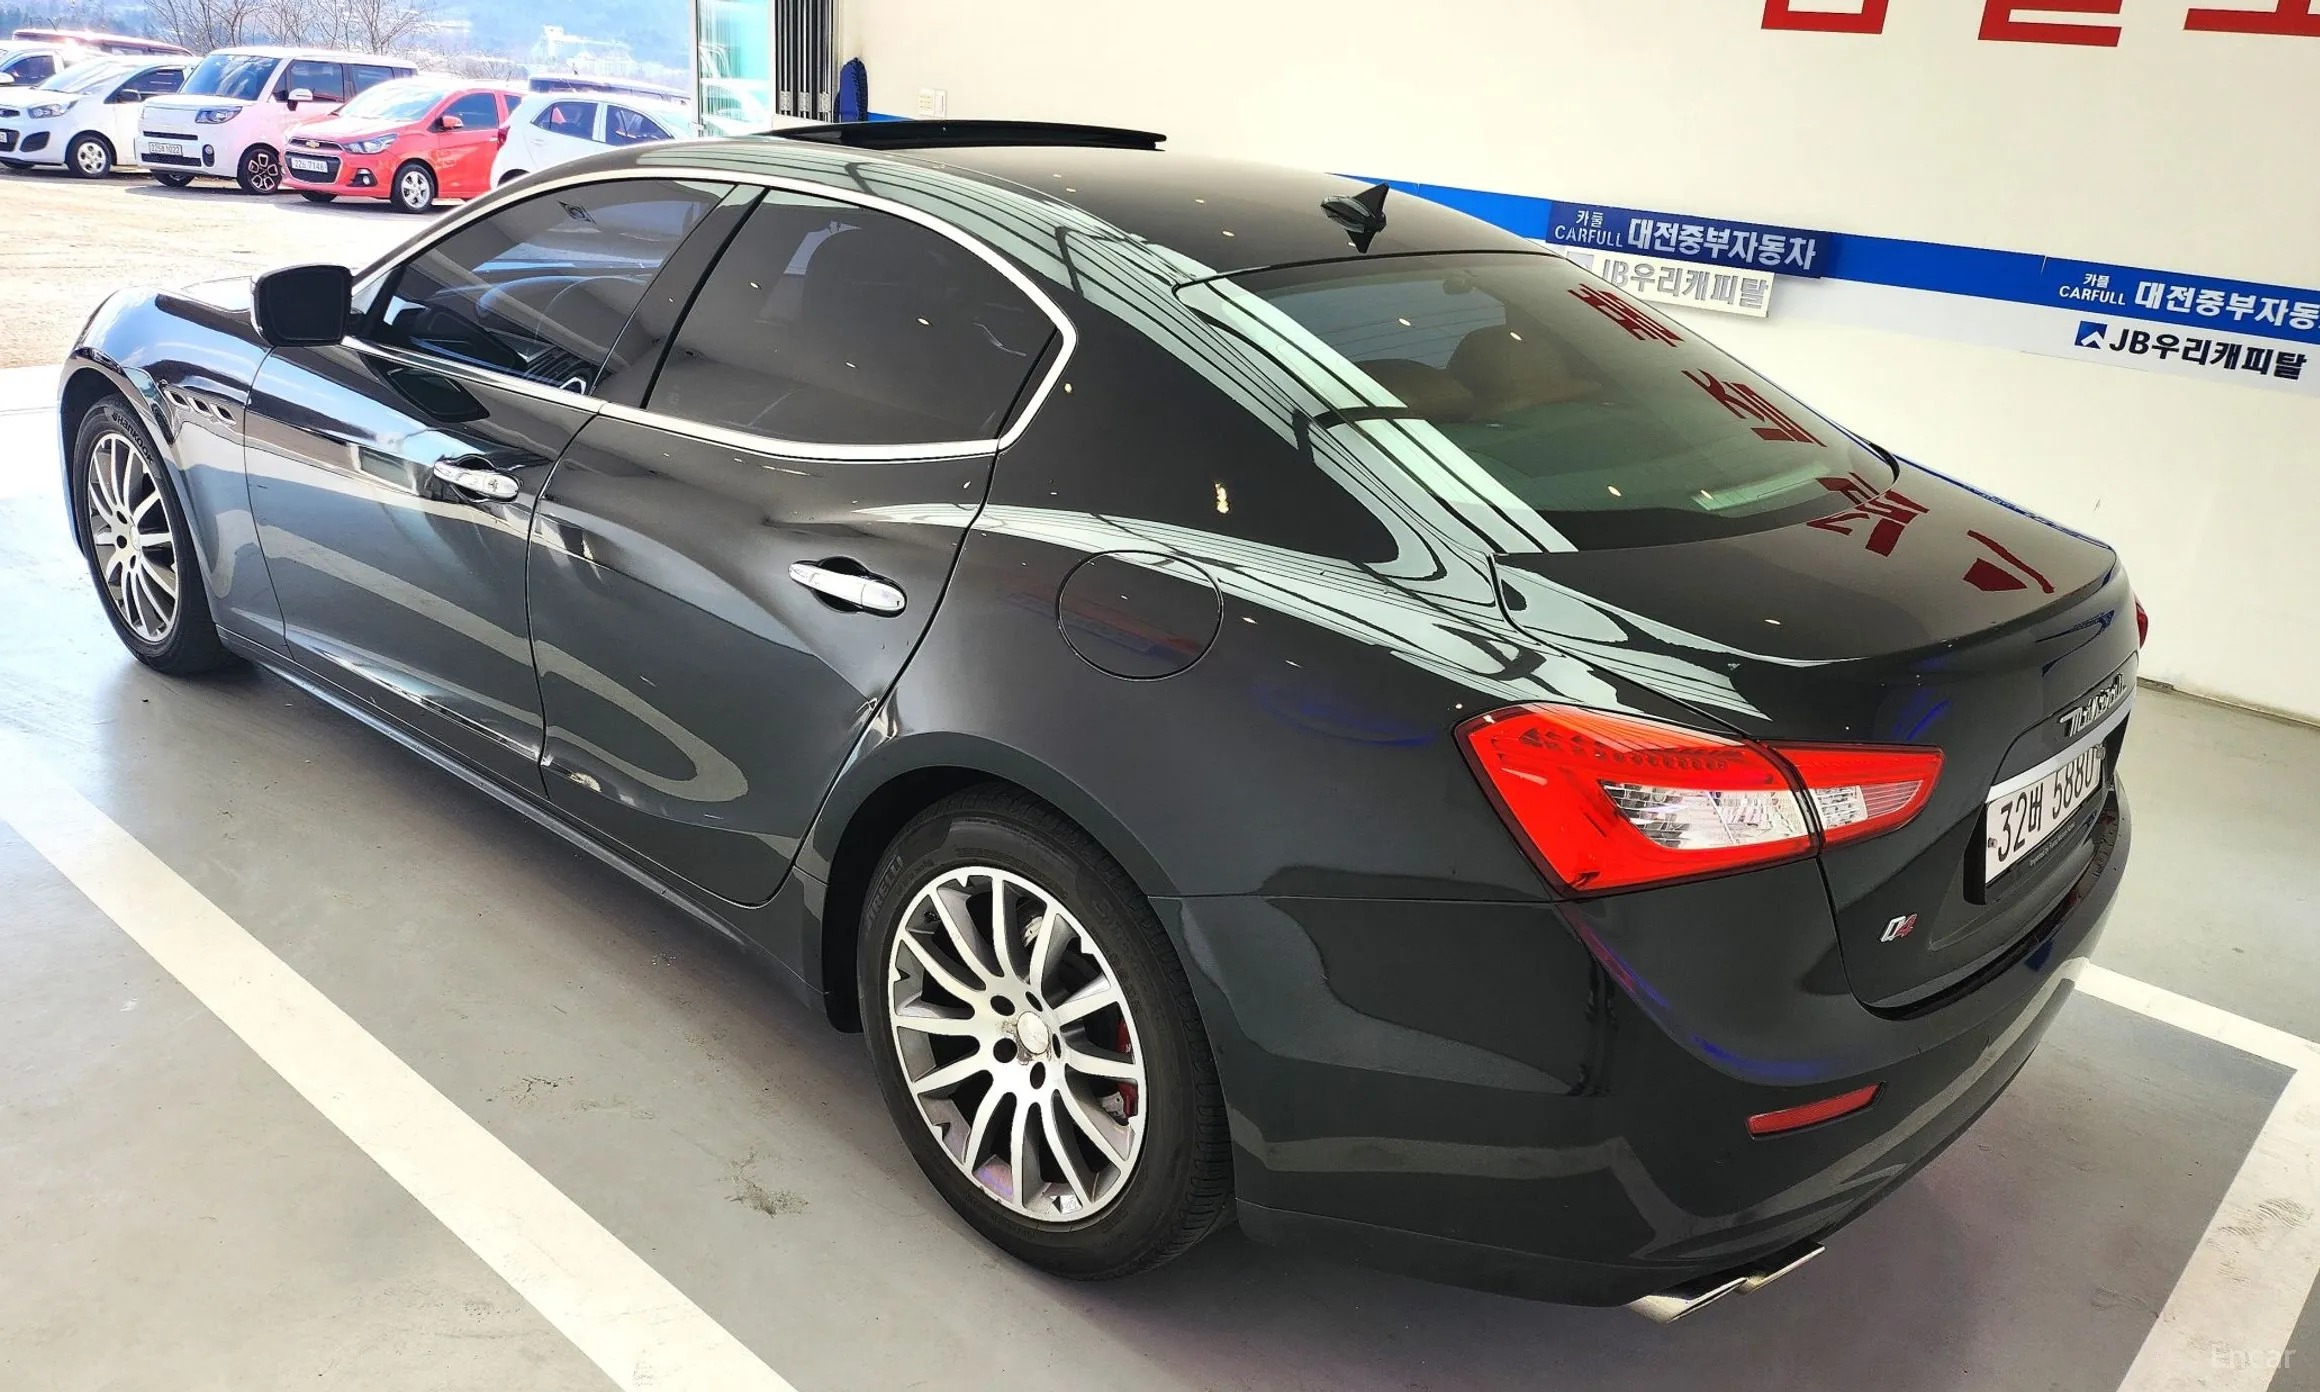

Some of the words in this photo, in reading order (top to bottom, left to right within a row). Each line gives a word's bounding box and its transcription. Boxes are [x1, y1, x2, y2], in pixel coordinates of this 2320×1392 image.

[1555, 224, 1623, 248] CARFULL
[1628, 218, 1817, 270] 대전중부자동차
[2059, 285, 2126, 306] CARFULL
[2135, 281, 2320, 330] 대전중부자동
[2109, 328, 2307, 380] JB우리캐피탈
[1998, 782, 2043, 862] 32버
[2052, 747, 2096, 820] 5880
[1881, 913, 1917, 942] Q4
